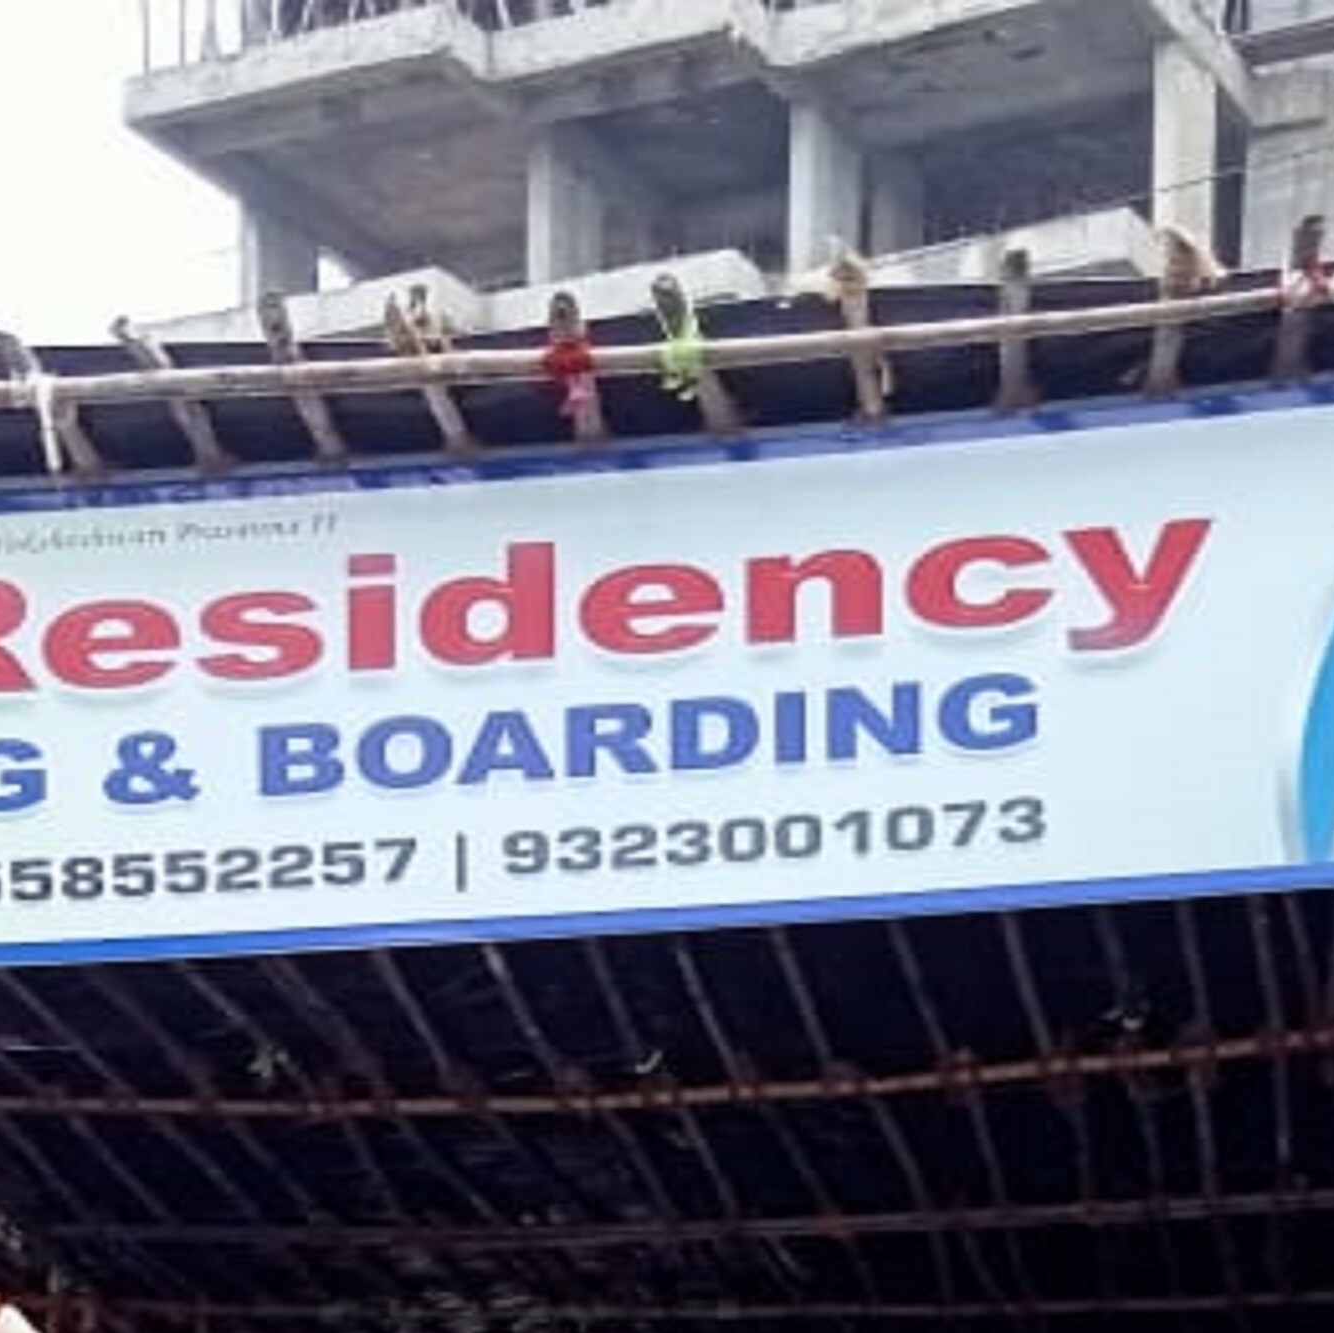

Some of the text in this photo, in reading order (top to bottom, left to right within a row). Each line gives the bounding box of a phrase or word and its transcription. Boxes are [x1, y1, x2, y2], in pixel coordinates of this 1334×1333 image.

[103, 729, 199, 808] &
[259, 672, 1040, 797] BOARDING
[502, 796, 1047, 876] 9323001073
